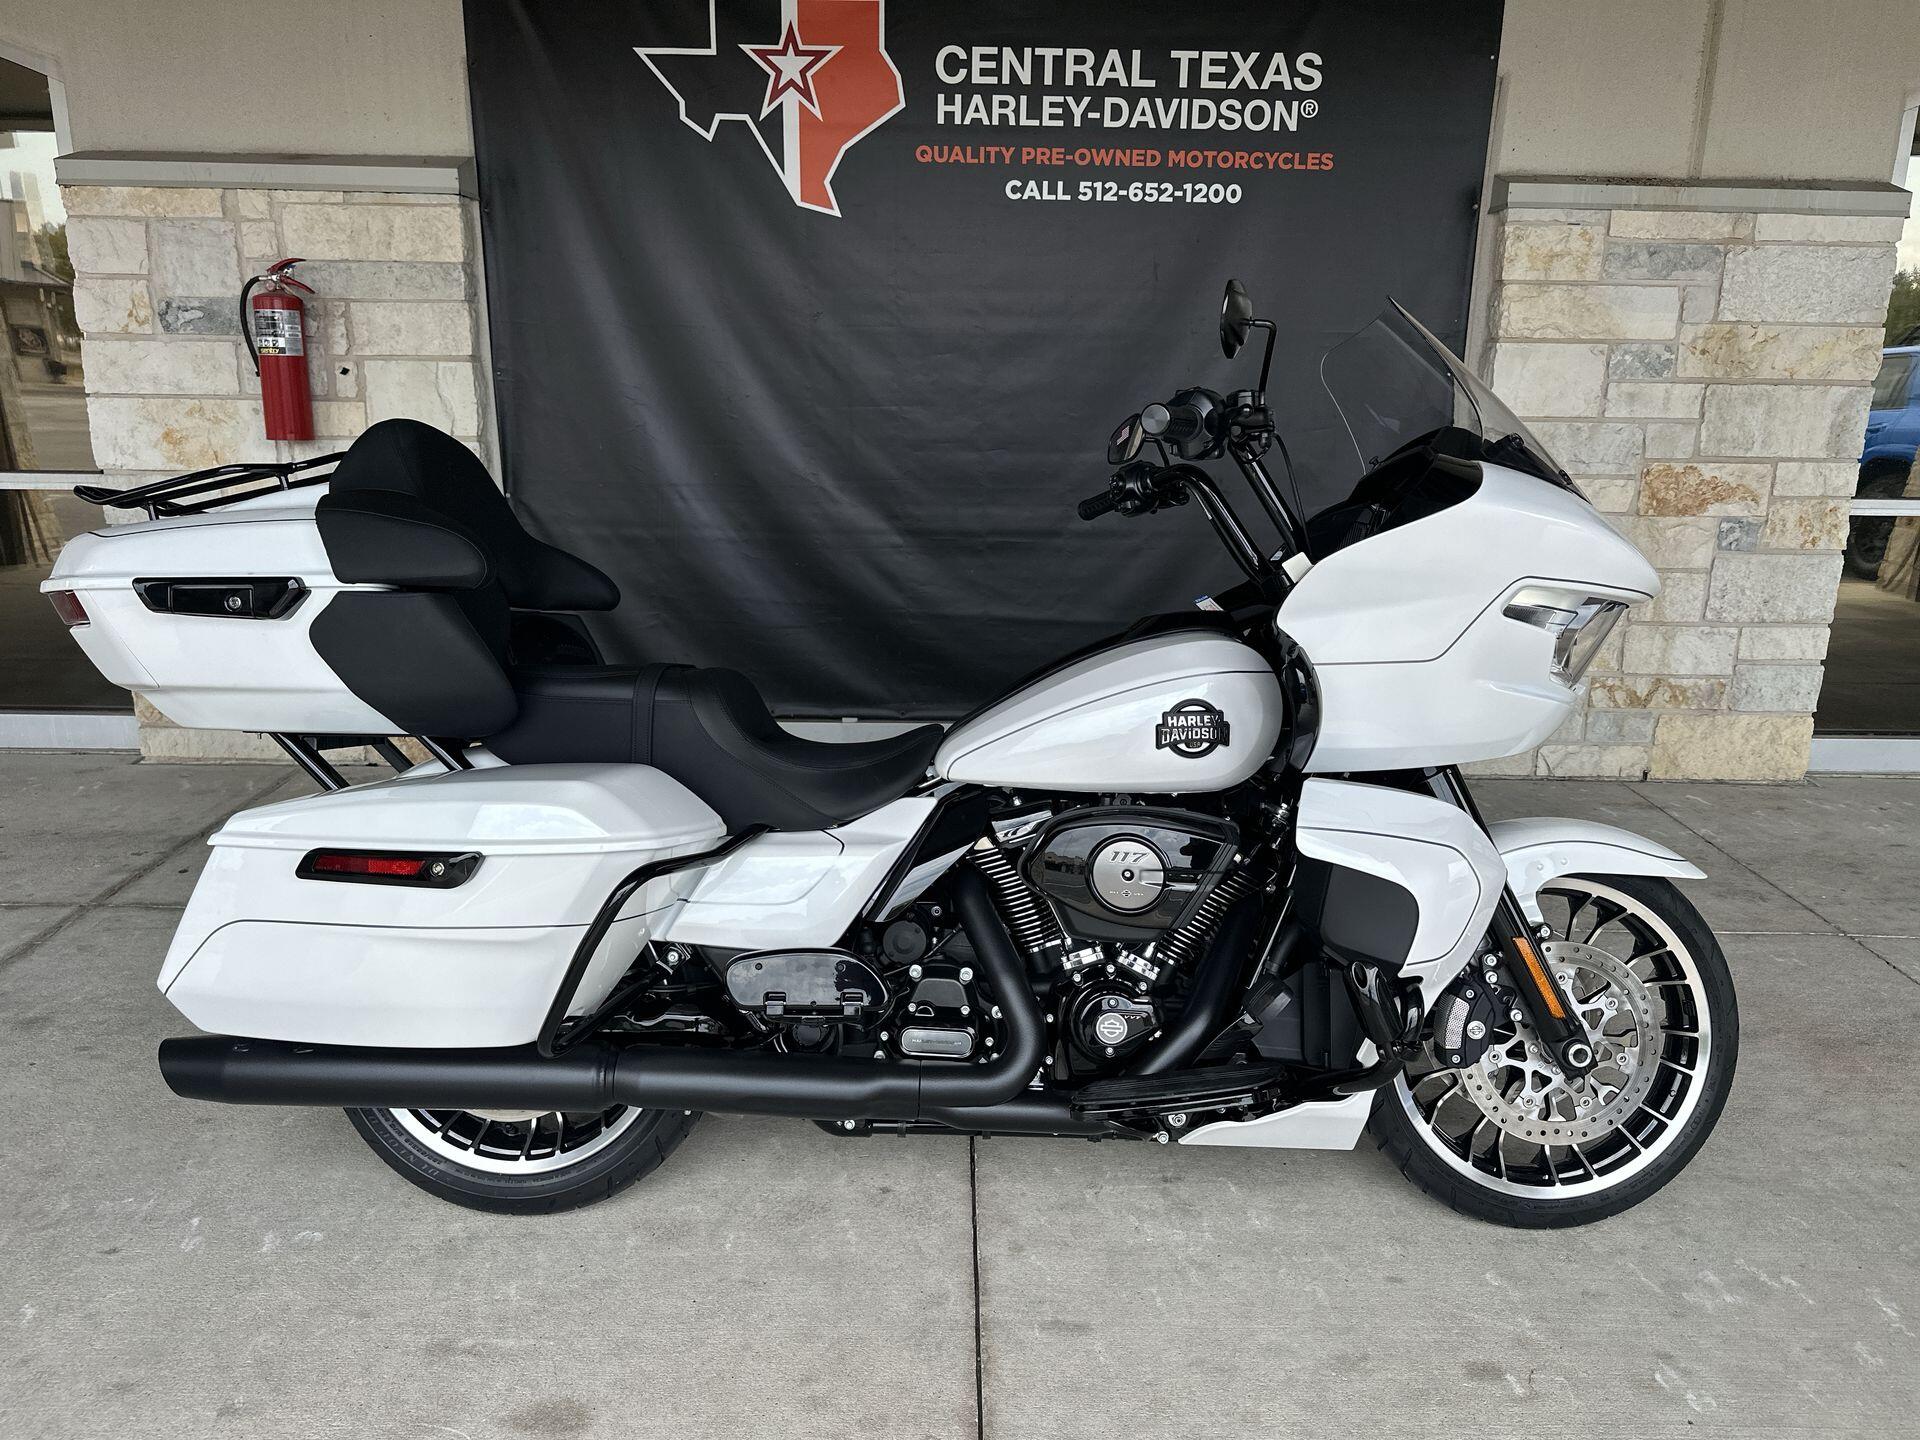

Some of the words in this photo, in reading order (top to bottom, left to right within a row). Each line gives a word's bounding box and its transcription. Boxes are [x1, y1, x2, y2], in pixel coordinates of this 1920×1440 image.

[936, 45, 1155, 87] CENTRAL
[1171, 51, 1322, 91] TEXAS
[916, 145, 1015, 163] QUALITY
[1022, 148, 1161, 166] PRE-OWNED
[1168, 151, 1333, 170] MOTORCYCLES
[1005, 180, 1071, 200] CALL
[1078, 182, 1242, 203] 512-652-1200
[1110, 851, 1149, 863] 117
